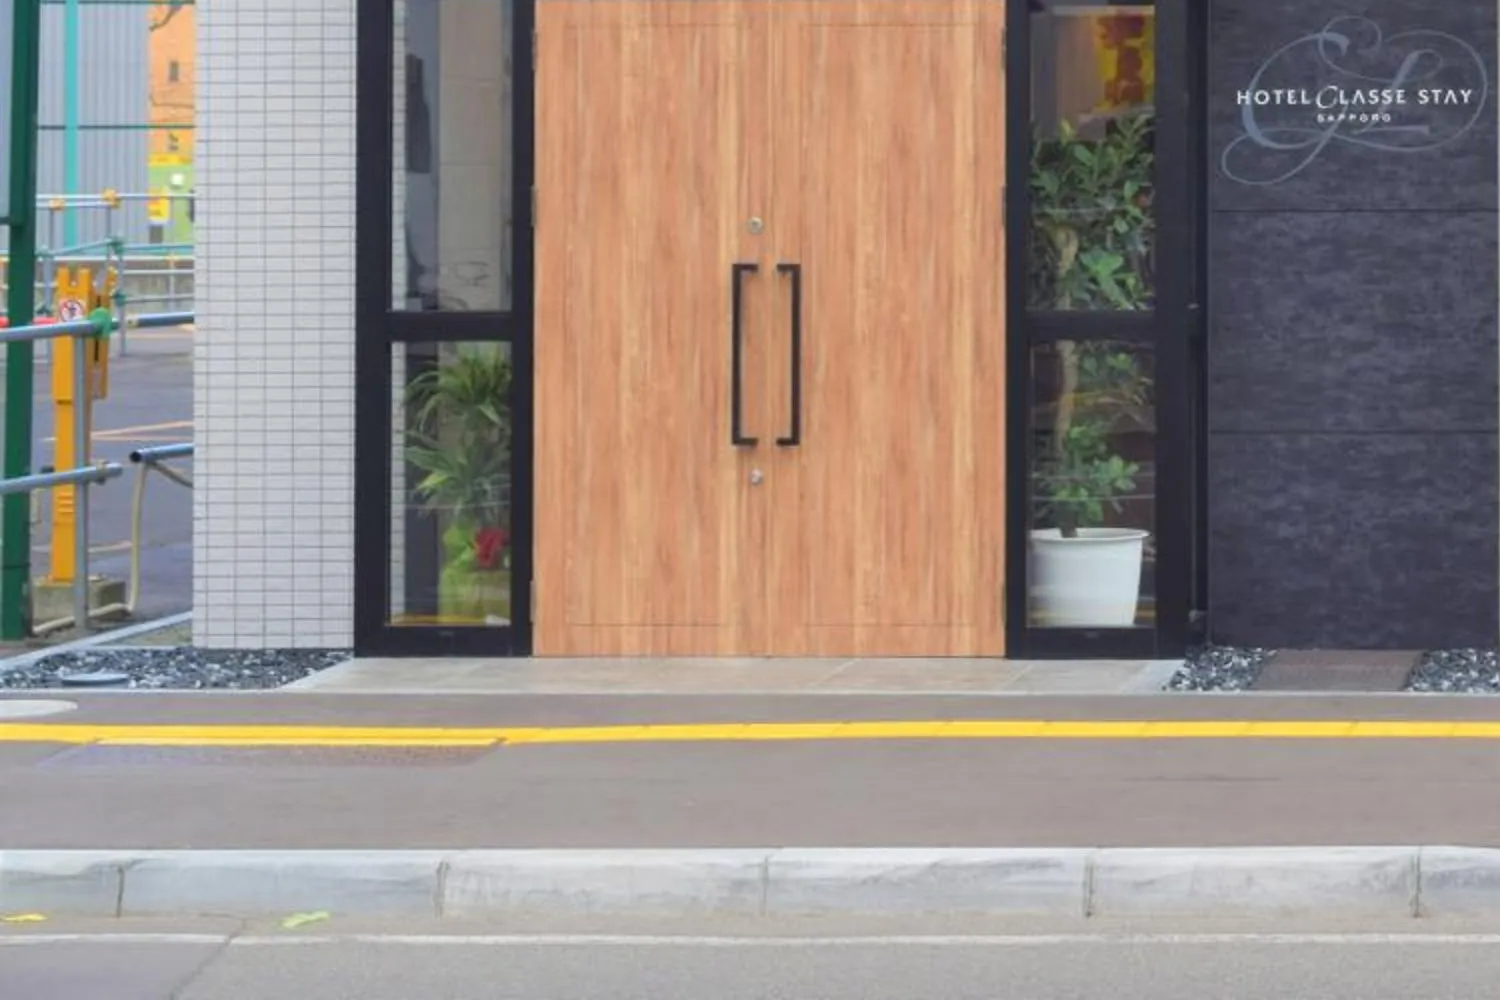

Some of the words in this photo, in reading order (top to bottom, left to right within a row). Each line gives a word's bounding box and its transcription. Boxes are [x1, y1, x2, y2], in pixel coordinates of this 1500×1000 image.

[1236, 89, 1311, 105] HOTEL
[1315, 85, 1407, 109] CLASSE
[1417, 89, 1473, 104] STAY
[1316, 112, 1392, 123] SAPPORO
